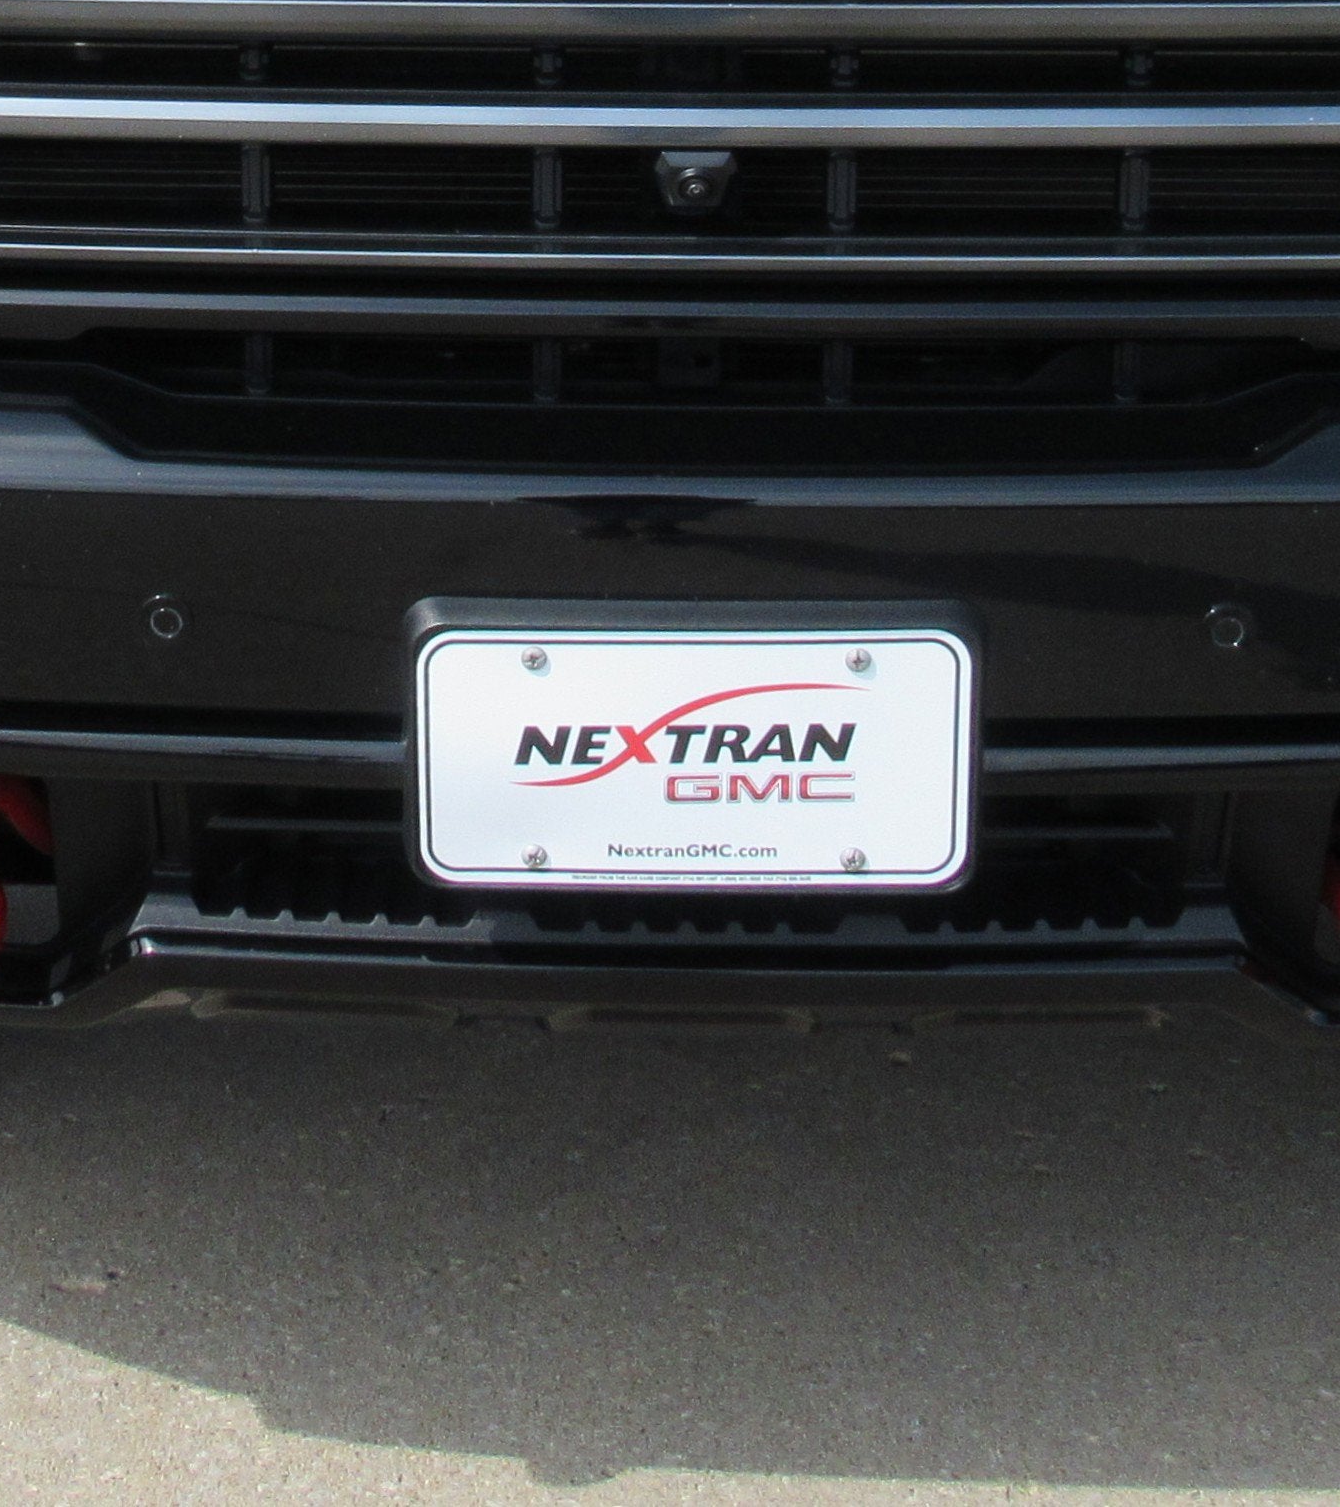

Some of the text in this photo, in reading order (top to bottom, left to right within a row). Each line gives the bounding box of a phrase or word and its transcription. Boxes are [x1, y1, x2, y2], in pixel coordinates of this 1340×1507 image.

[513, 722, 857, 766] NEXTRAN
[664, 770, 856, 804] GMC
[607, 843, 778, 859] NextranGMC.com
